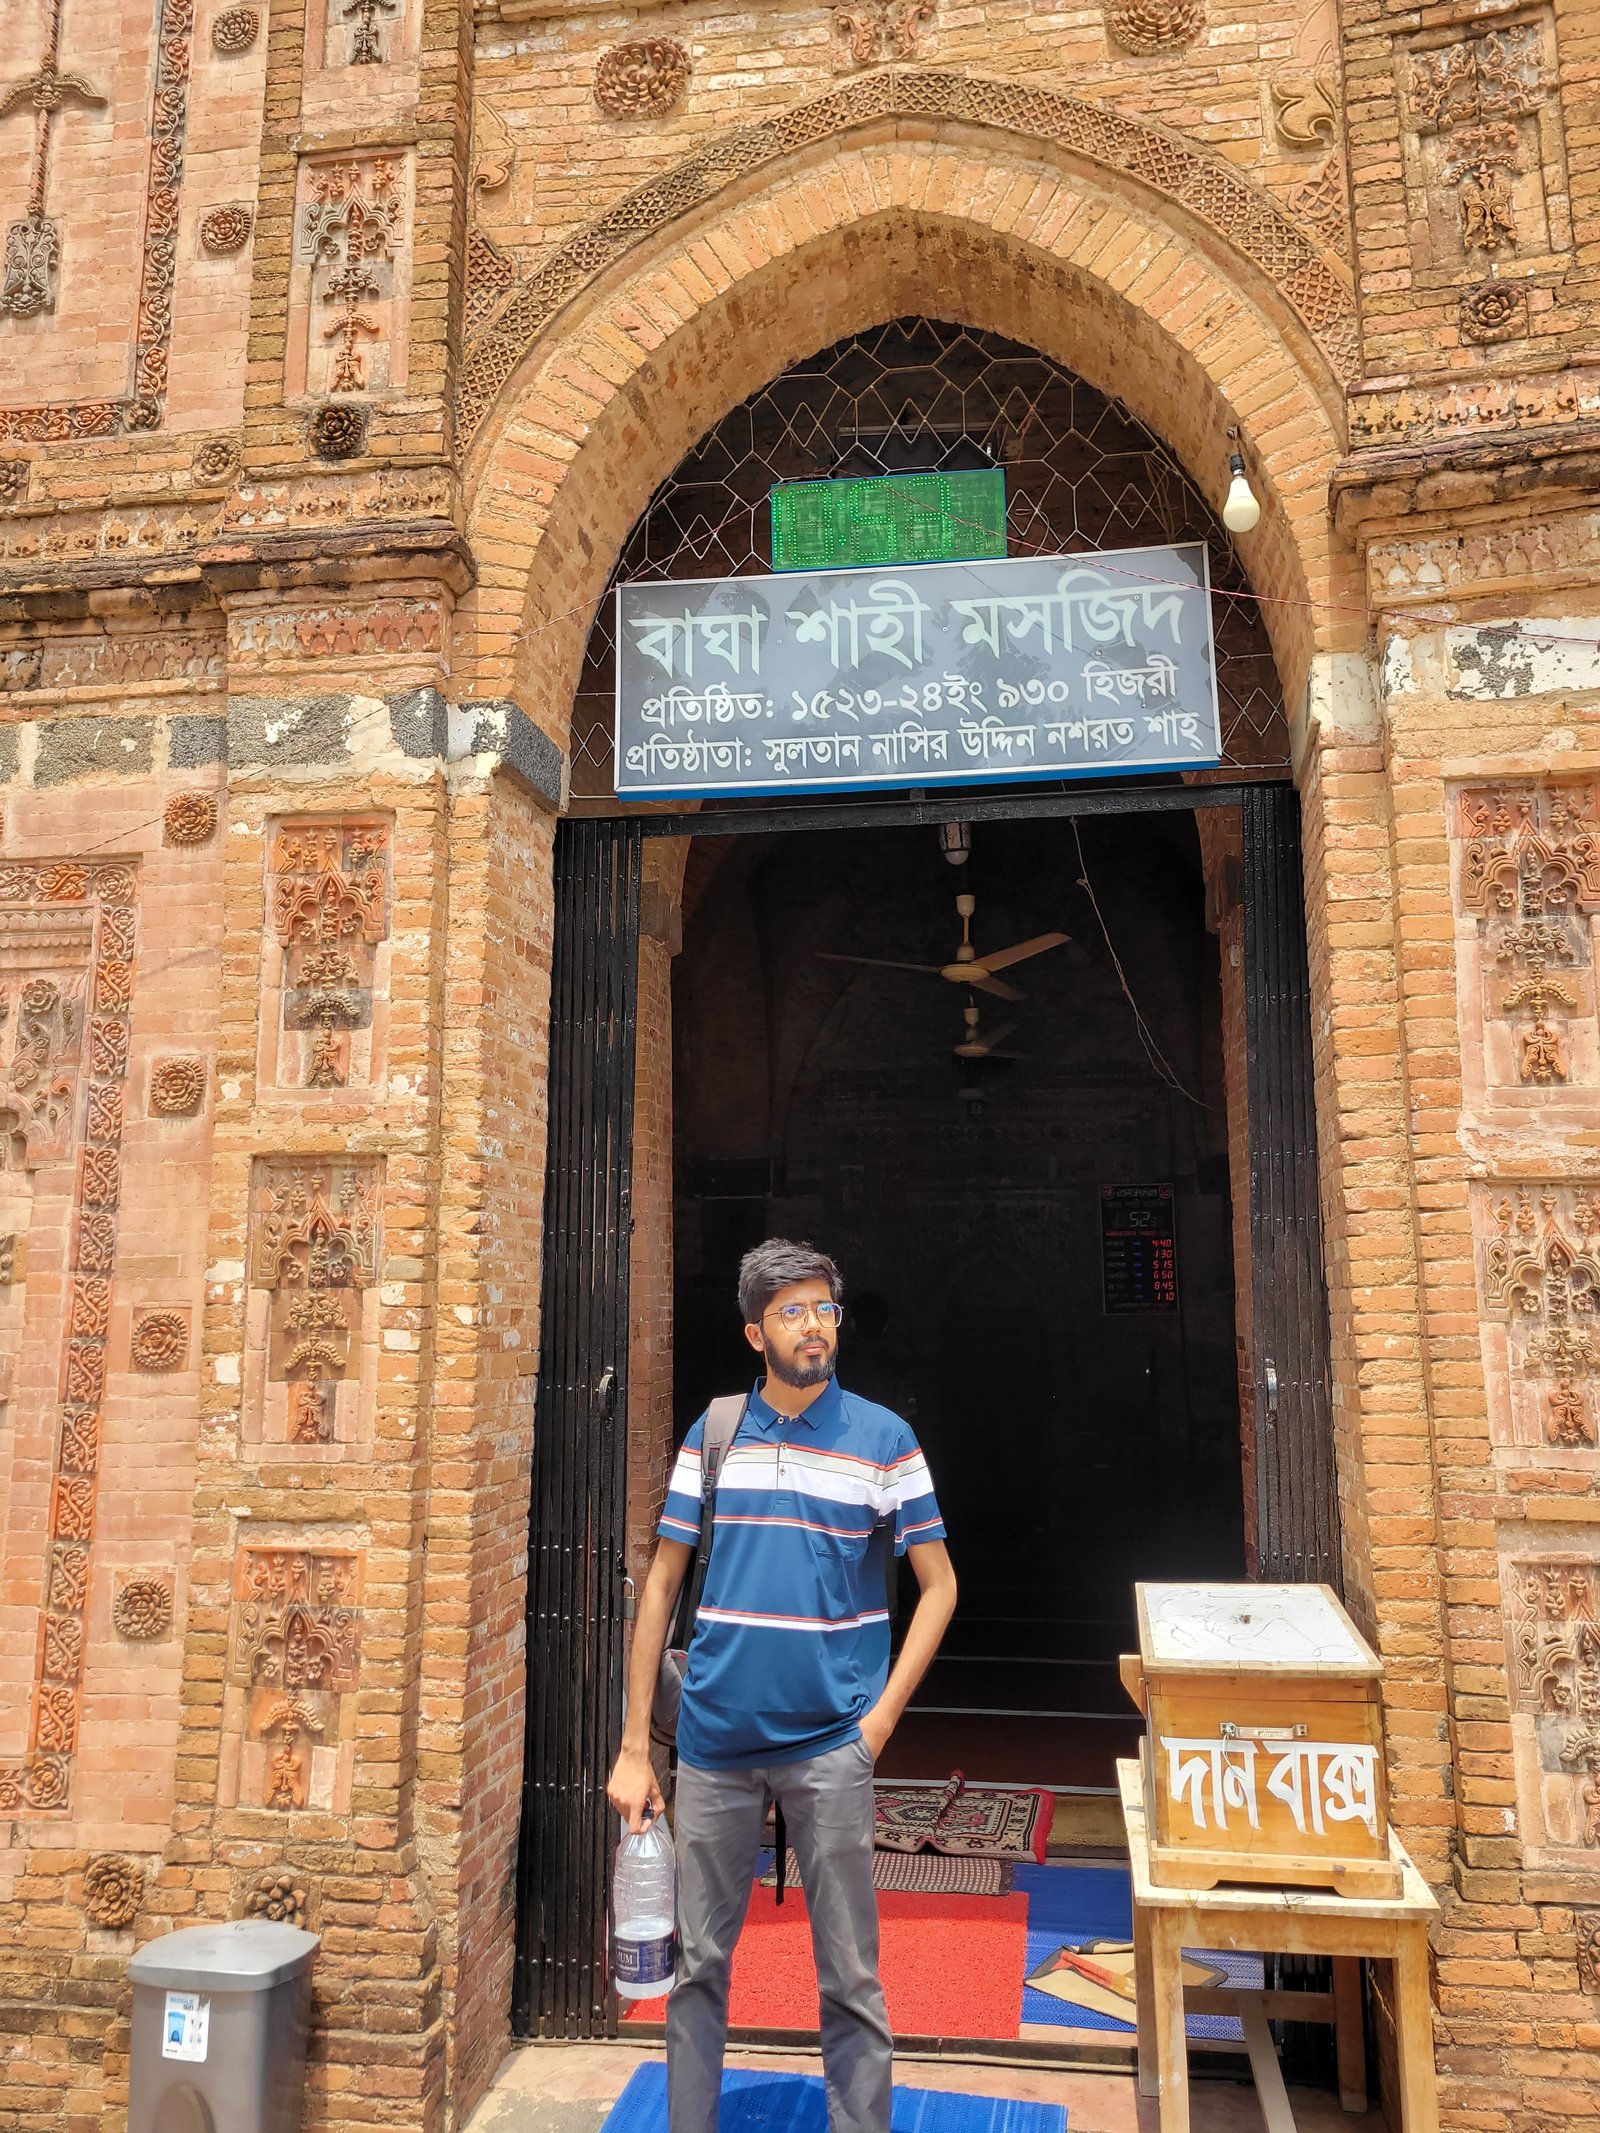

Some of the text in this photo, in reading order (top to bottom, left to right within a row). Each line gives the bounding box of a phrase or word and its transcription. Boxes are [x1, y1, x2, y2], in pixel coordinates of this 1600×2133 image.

[627, 568, 1190, 679] বাঘা শাহী মসজিদ
[791, 671, 987, 723] ১৫২৩-২৪ইং
[996, 678, 1069, 709] ৯৩০
[1080, 654, 1179, 705] হিজরী
[762, 731, 863, 774] সুলতান
[868, 720, 949, 766] নাসির
[957, 715, 1038, 758] উদ্দিন
[1044, 717, 1135, 755] নশরত
[1160, 1735, 1384, 1840] দান বাক্স
